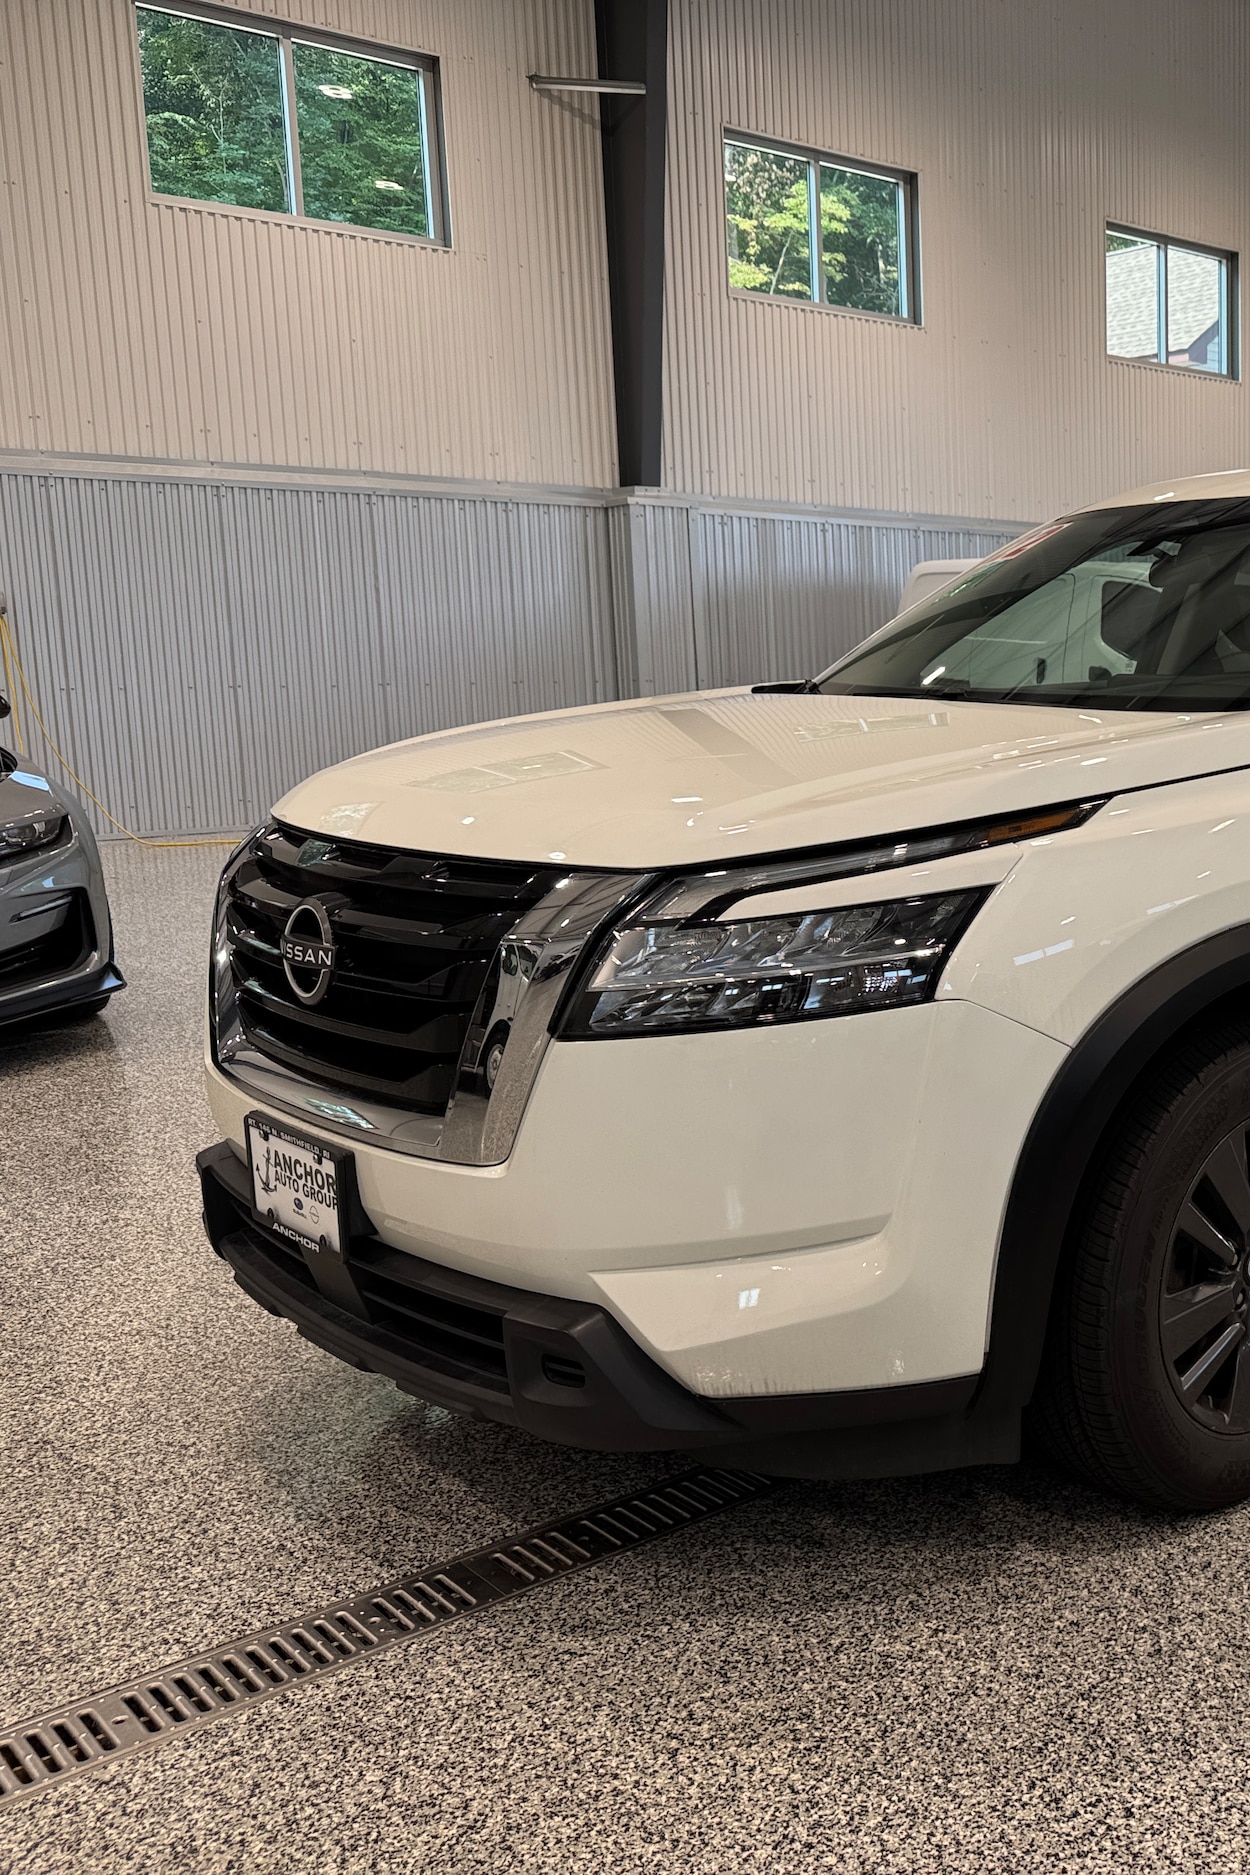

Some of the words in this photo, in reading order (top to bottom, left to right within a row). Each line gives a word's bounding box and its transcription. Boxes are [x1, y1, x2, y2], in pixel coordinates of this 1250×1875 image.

[322, 1149, 331, 1160] RI
[274, 1149, 337, 1197] ANCHOR
[274, 1169, 301, 1194] AUTO
[272, 1222, 320, 1254] ANCHOR
